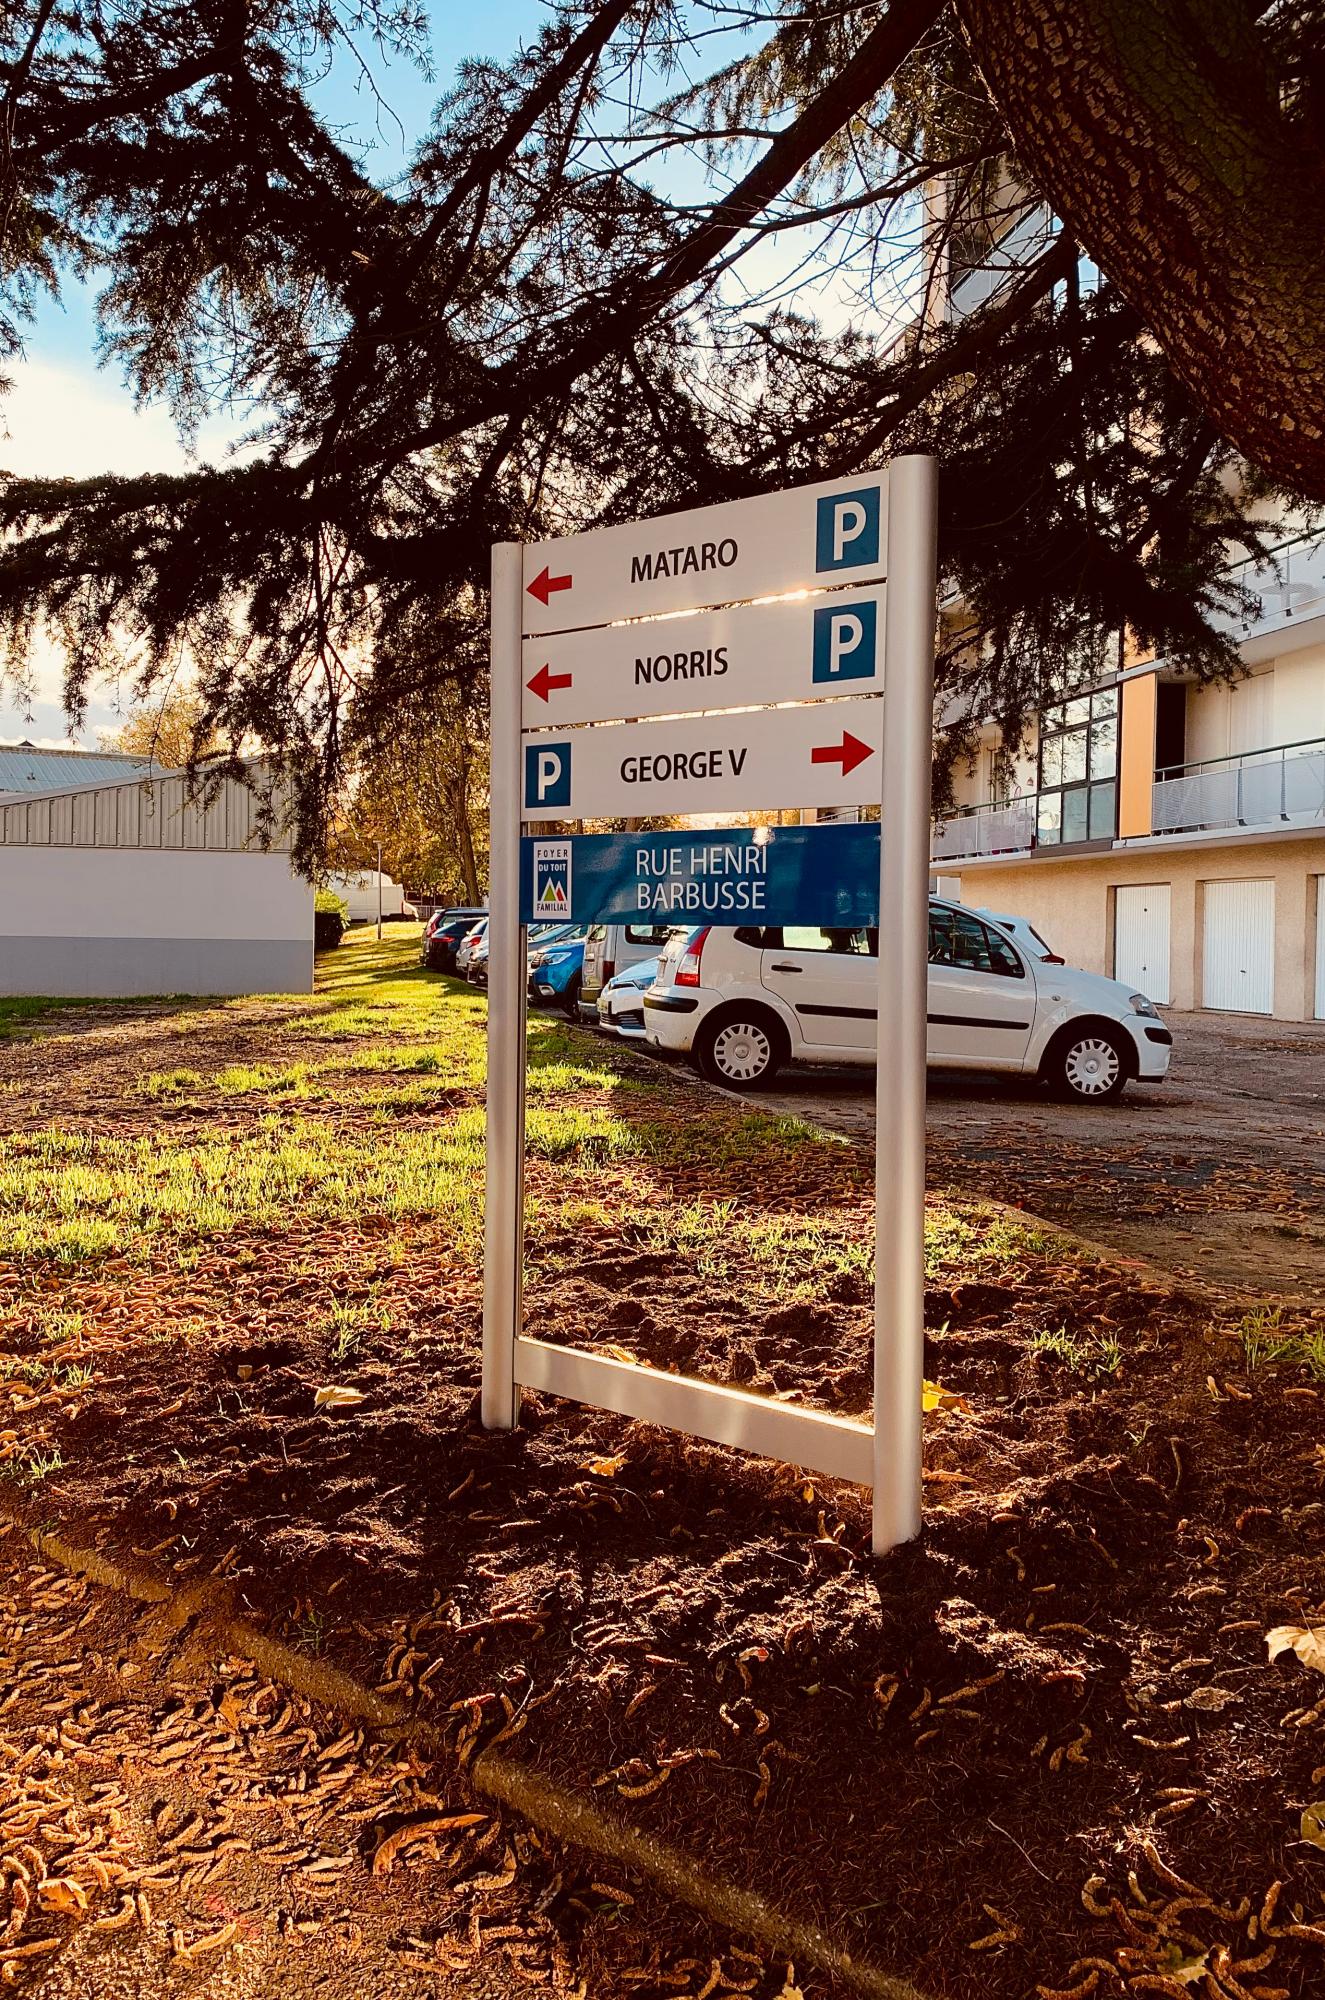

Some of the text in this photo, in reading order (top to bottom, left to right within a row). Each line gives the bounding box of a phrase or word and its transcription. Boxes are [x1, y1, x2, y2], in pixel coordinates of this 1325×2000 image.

[833, 501, 866, 561] P
[630, 538, 738, 583] MATARO
[829, 613, 863, 672] P
[635, 647, 728, 685] NORRIS
[537, 751, 561, 801] P
[620, 748, 748, 783] GEORGE V
[537, 849, 568, 858] FOYER
[538, 863, 567, 872] DU TOIT
[636, 845, 767, 876] RUE HENRI
[536, 903, 568, 912] FAMILIAL
[637, 881, 766, 910] BARBUSSE
